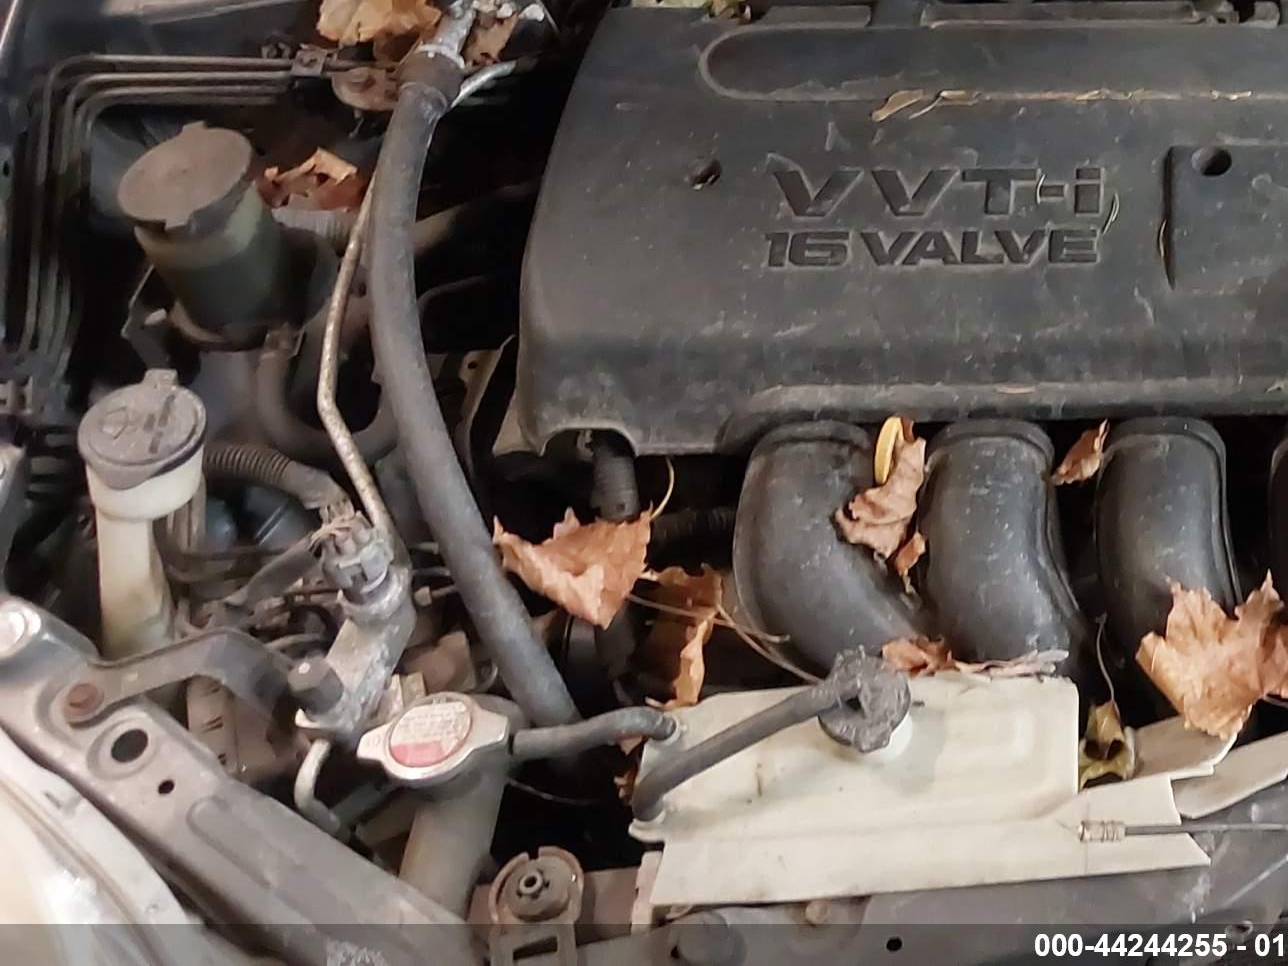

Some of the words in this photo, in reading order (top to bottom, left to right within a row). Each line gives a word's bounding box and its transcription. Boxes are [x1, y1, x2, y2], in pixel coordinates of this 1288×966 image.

[771, 167, 1102, 217] VVT-i
[764, 230, 851, 267] 16
[860, 229, 1099, 266] VALVE
